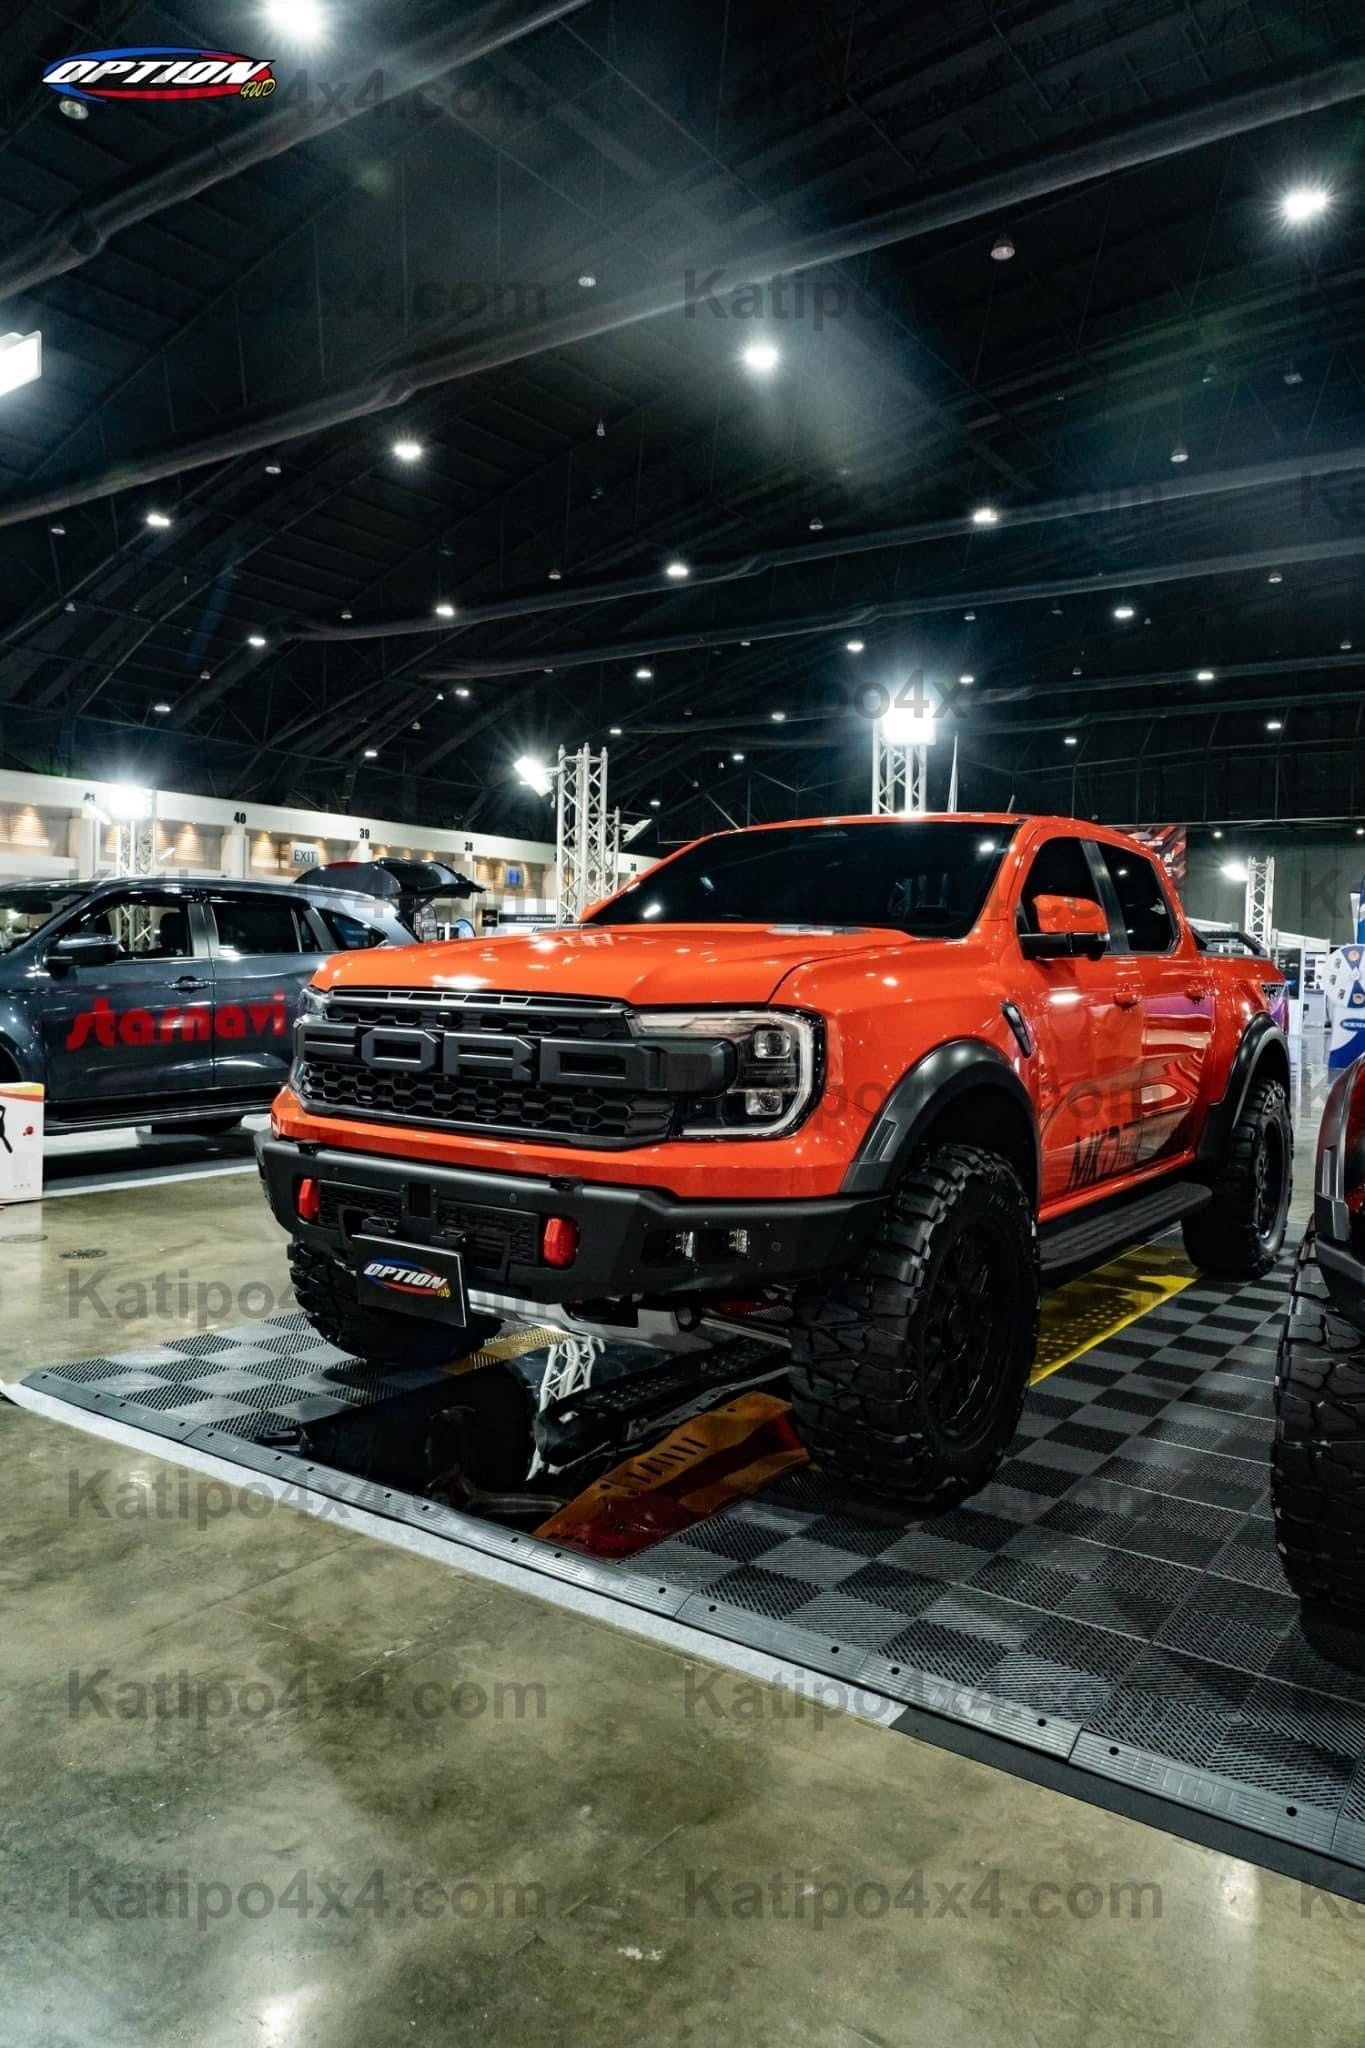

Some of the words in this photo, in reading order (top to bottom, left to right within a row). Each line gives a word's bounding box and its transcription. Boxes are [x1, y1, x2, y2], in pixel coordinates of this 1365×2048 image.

[234, 811, 246, 825] 40
[359, 828, 370, 840] 39
[294, 850, 318, 864] EXIT
[65, 988, 287, 1053] starnavi
[302, 1023, 655, 1092] FORD
[363, 1262, 448, 1290] OPTION
